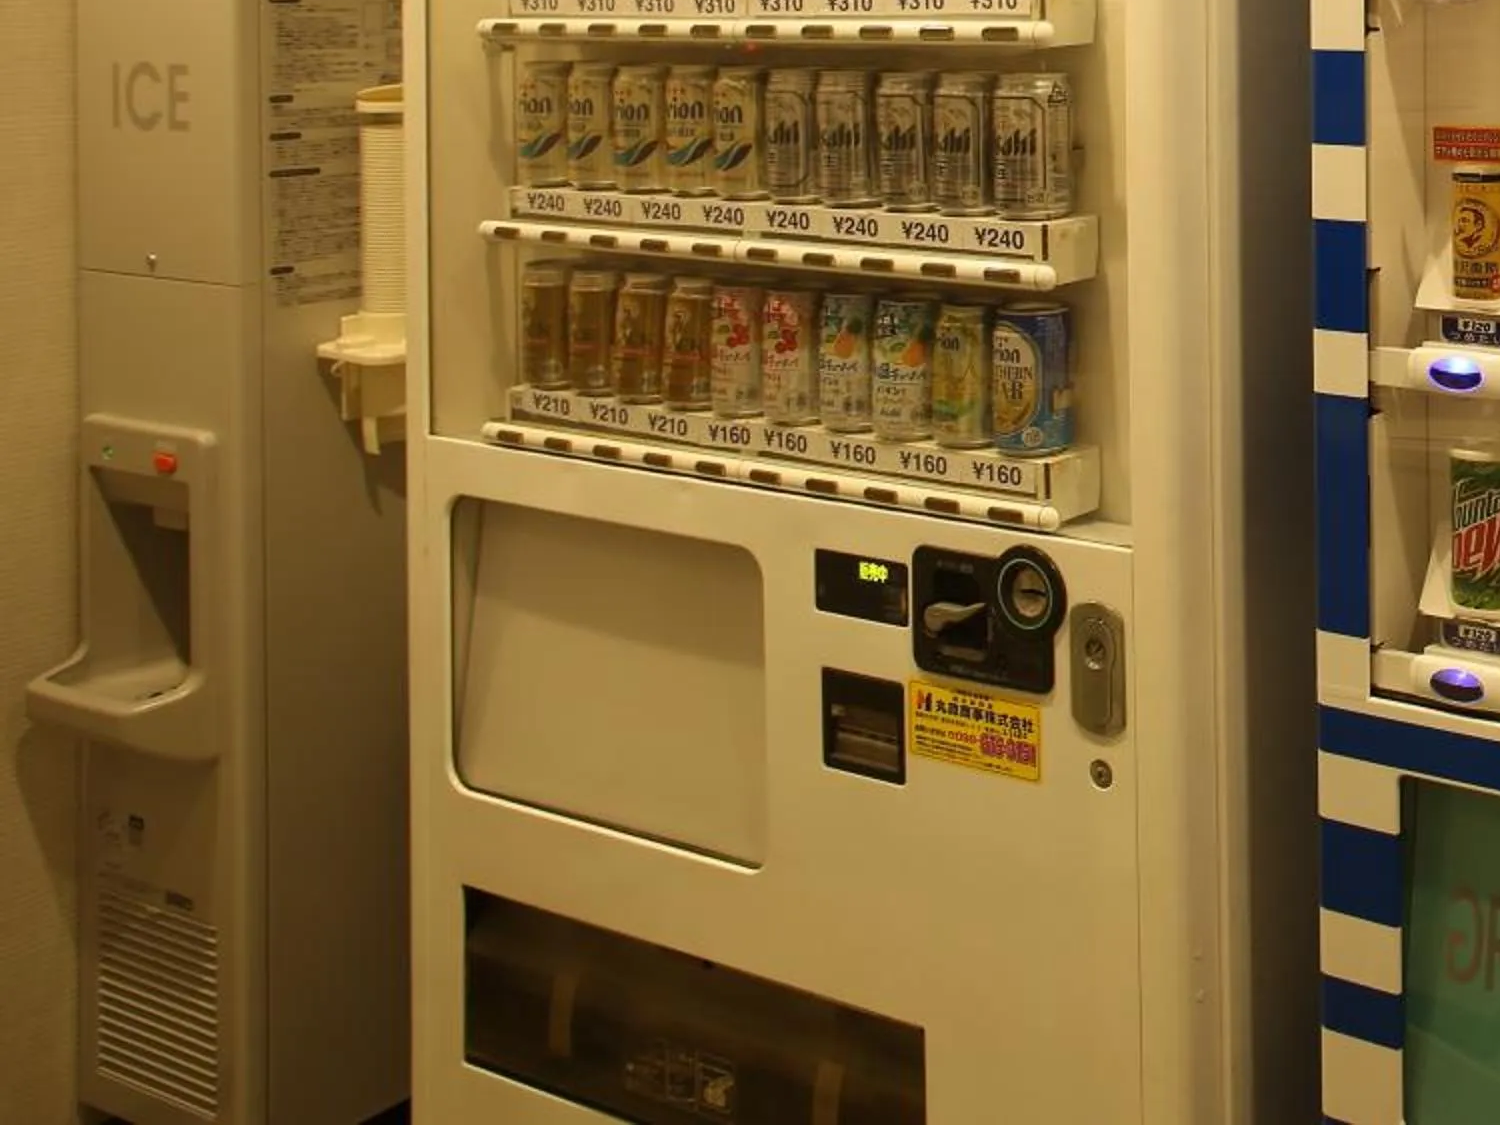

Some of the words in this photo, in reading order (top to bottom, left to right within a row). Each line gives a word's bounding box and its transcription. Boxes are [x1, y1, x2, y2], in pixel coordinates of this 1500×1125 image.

[112, 61, 192, 133] ICE
[527, 192, 565, 212] ¥240
[583, 197, 623, 217] ¥240
[641, 202, 682, 221] ¥240
[703, 206, 745, 226] ¥240
[767, 210, 811, 231] ¥240
[832, 216, 879, 238] ¥240
[901, 221, 949, 243] ¥240
[974, 226, 1025, 250] ¥240
[1460, 321, 1491, 332] ¥120
[532, 393, 571, 416] ¥210
[589, 402, 629, 425] ¥210
[648, 412, 689, 435] ¥210
[708, 424, 751, 445] ¥160
[764, 429, 808, 454] ¥160
[830, 440, 877, 465] ¥160
[900, 451, 948, 475] ¥160
[972, 461, 1023, 486] ¥160
[1462, 628, 1493, 641] ¥120
